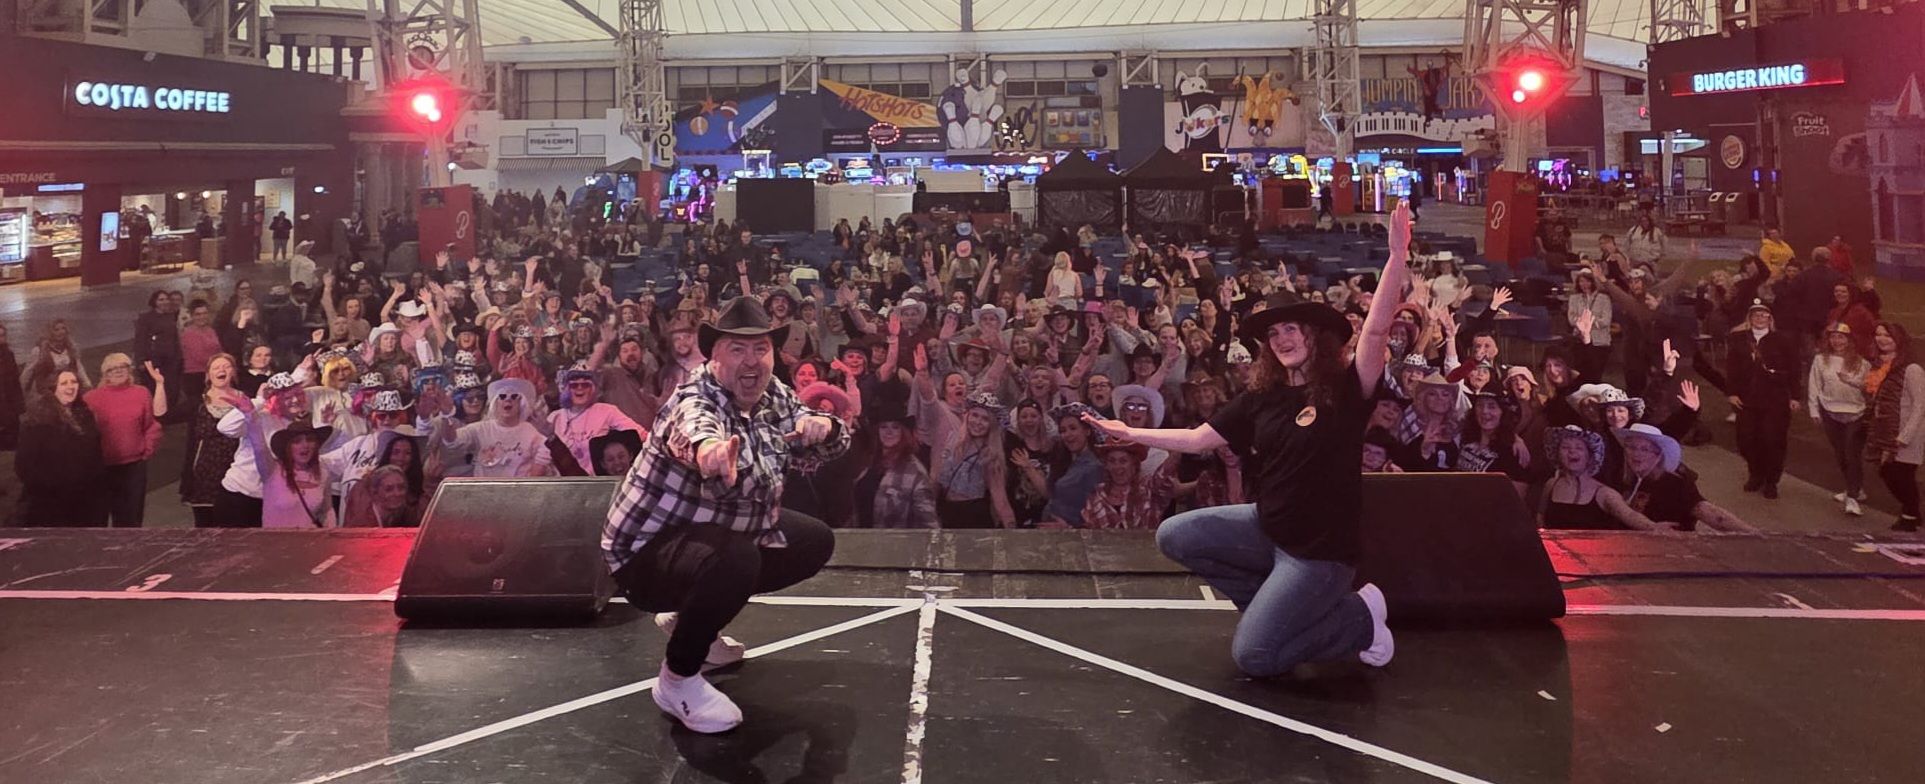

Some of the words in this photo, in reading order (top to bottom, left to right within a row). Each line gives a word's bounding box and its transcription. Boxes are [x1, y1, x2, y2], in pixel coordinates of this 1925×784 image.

[1693, 69, 1757, 93] BURGER
[1758, 64, 1804, 88] KING
[75, 81, 149, 110] COSTA
[154, 87, 230, 113] COFFEE
[840, 87, 926, 119] HOTSHOTS
[1797, 115, 1824, 126] Fruit
[0, 172, 56, 184] ENTRANCE
